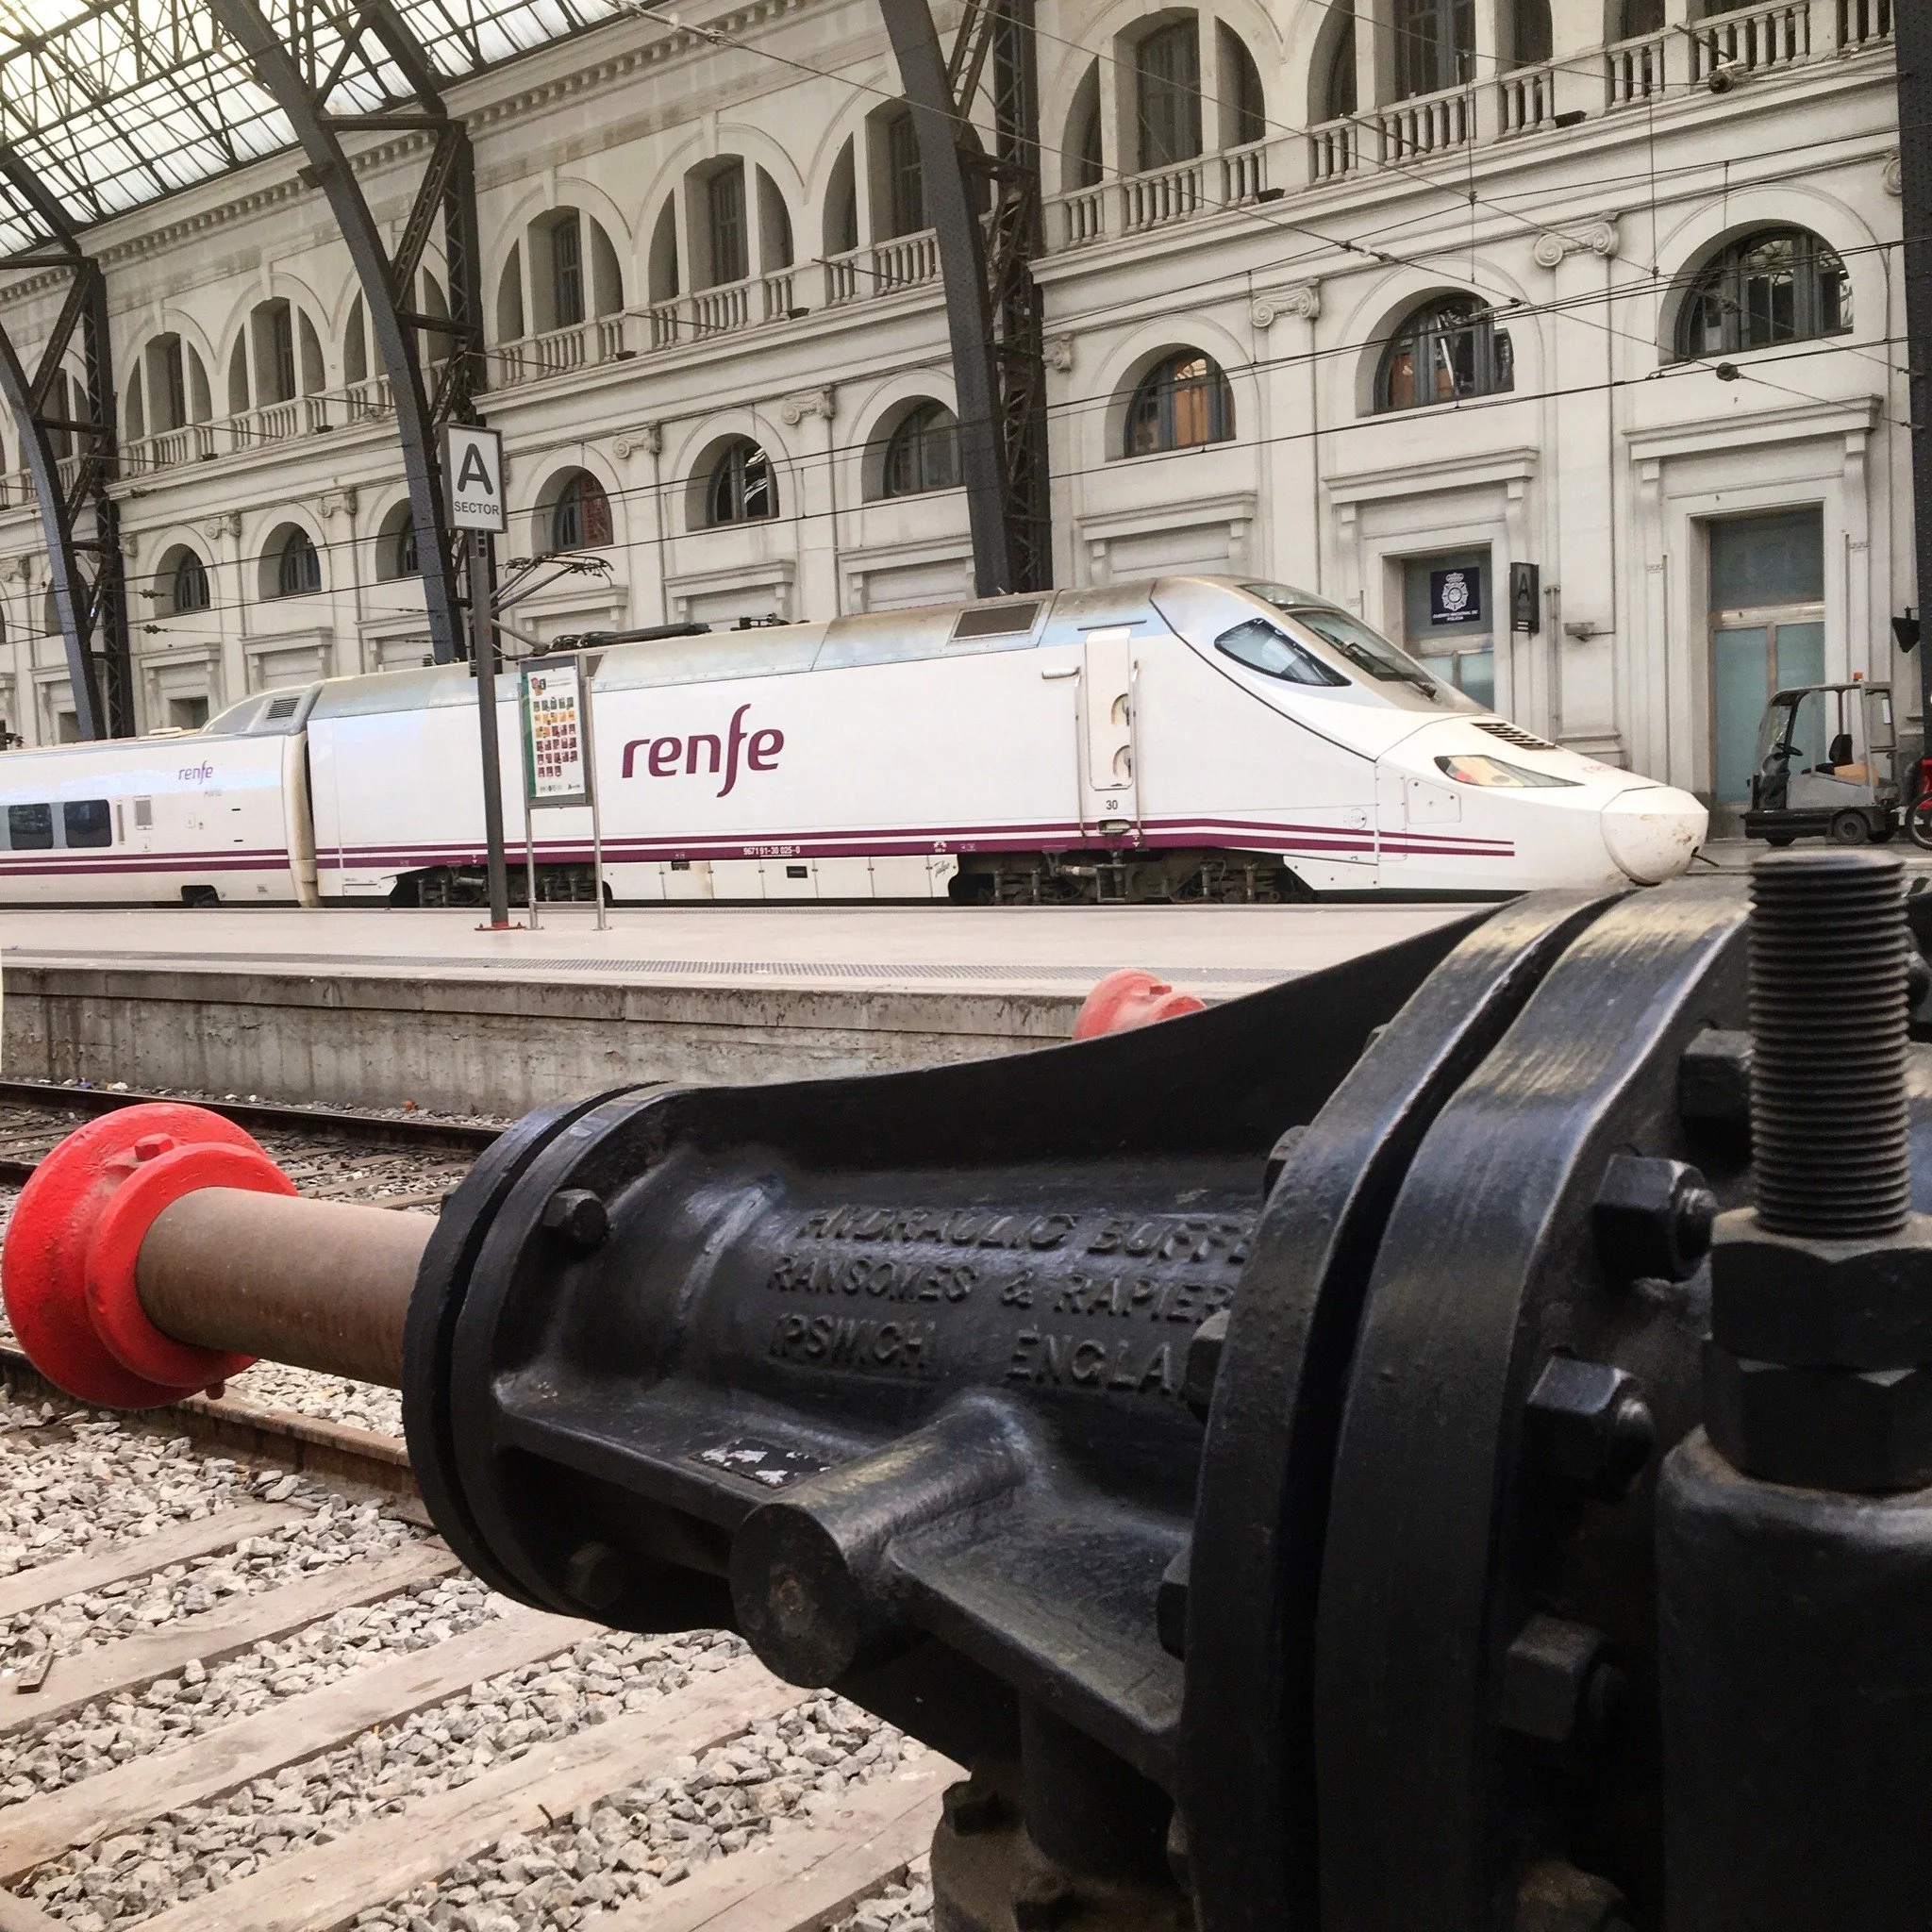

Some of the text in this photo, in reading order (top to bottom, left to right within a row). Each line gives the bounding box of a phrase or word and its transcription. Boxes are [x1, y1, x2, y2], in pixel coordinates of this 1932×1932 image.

[457, 442, 493, 495] A
[454, 500, 500, 515] SECTOR
[177, 759, 213, 785] renfe
[622, 703, 785, 798] renfe
[1106, 799, 1118, 810] 30
[766, 1253, 1236, 1325] RANSOMES & RAPIER
[769, 1312, 936, 1369] IPSWICH
